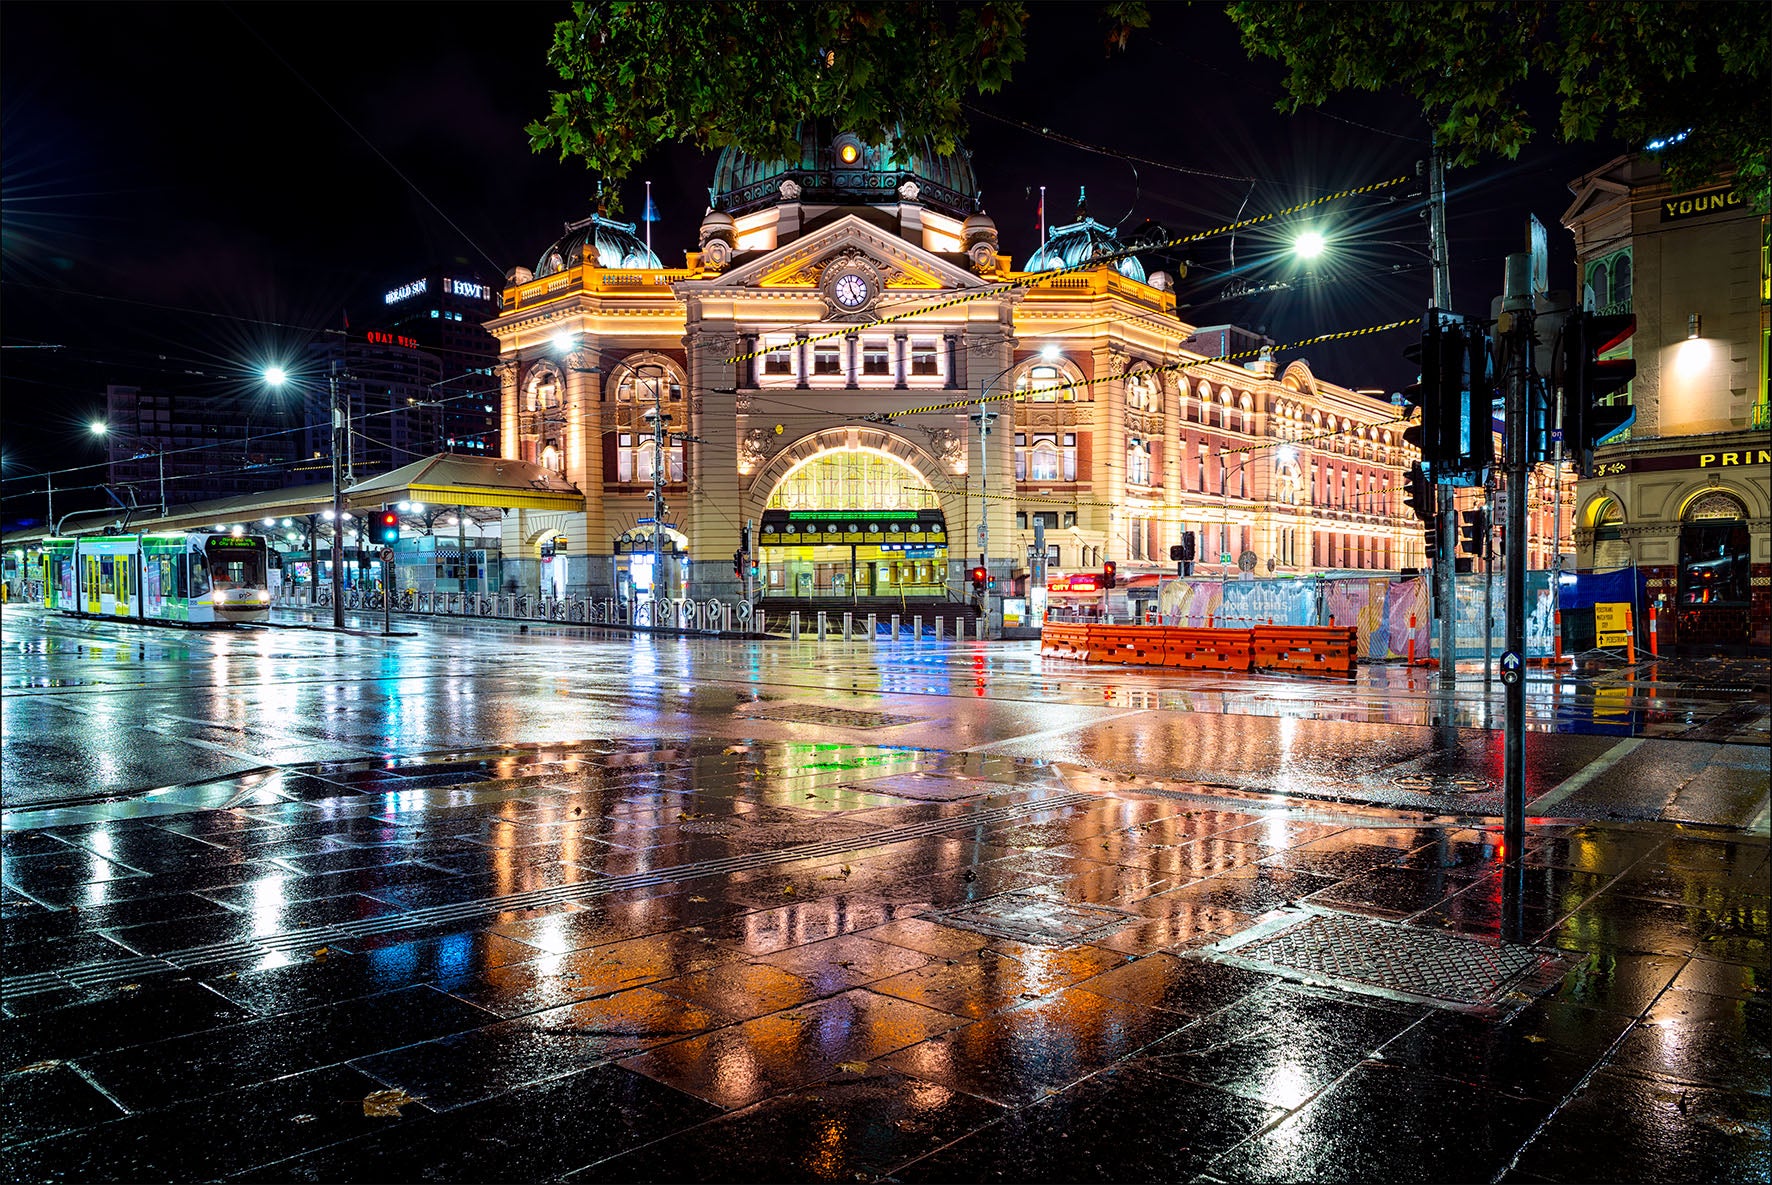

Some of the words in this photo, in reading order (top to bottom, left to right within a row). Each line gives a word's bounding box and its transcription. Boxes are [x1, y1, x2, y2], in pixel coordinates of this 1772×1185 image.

[1666, 191, 1741, 216] YOUNG
[385, 286, 411, 305] HERALD
[412, 279, 427, 295] SUN
[453, 280, 482, 299] HWT
[367, 331, 393, 344] QUAY
[1700, 450, 1770, 467] PRIN
